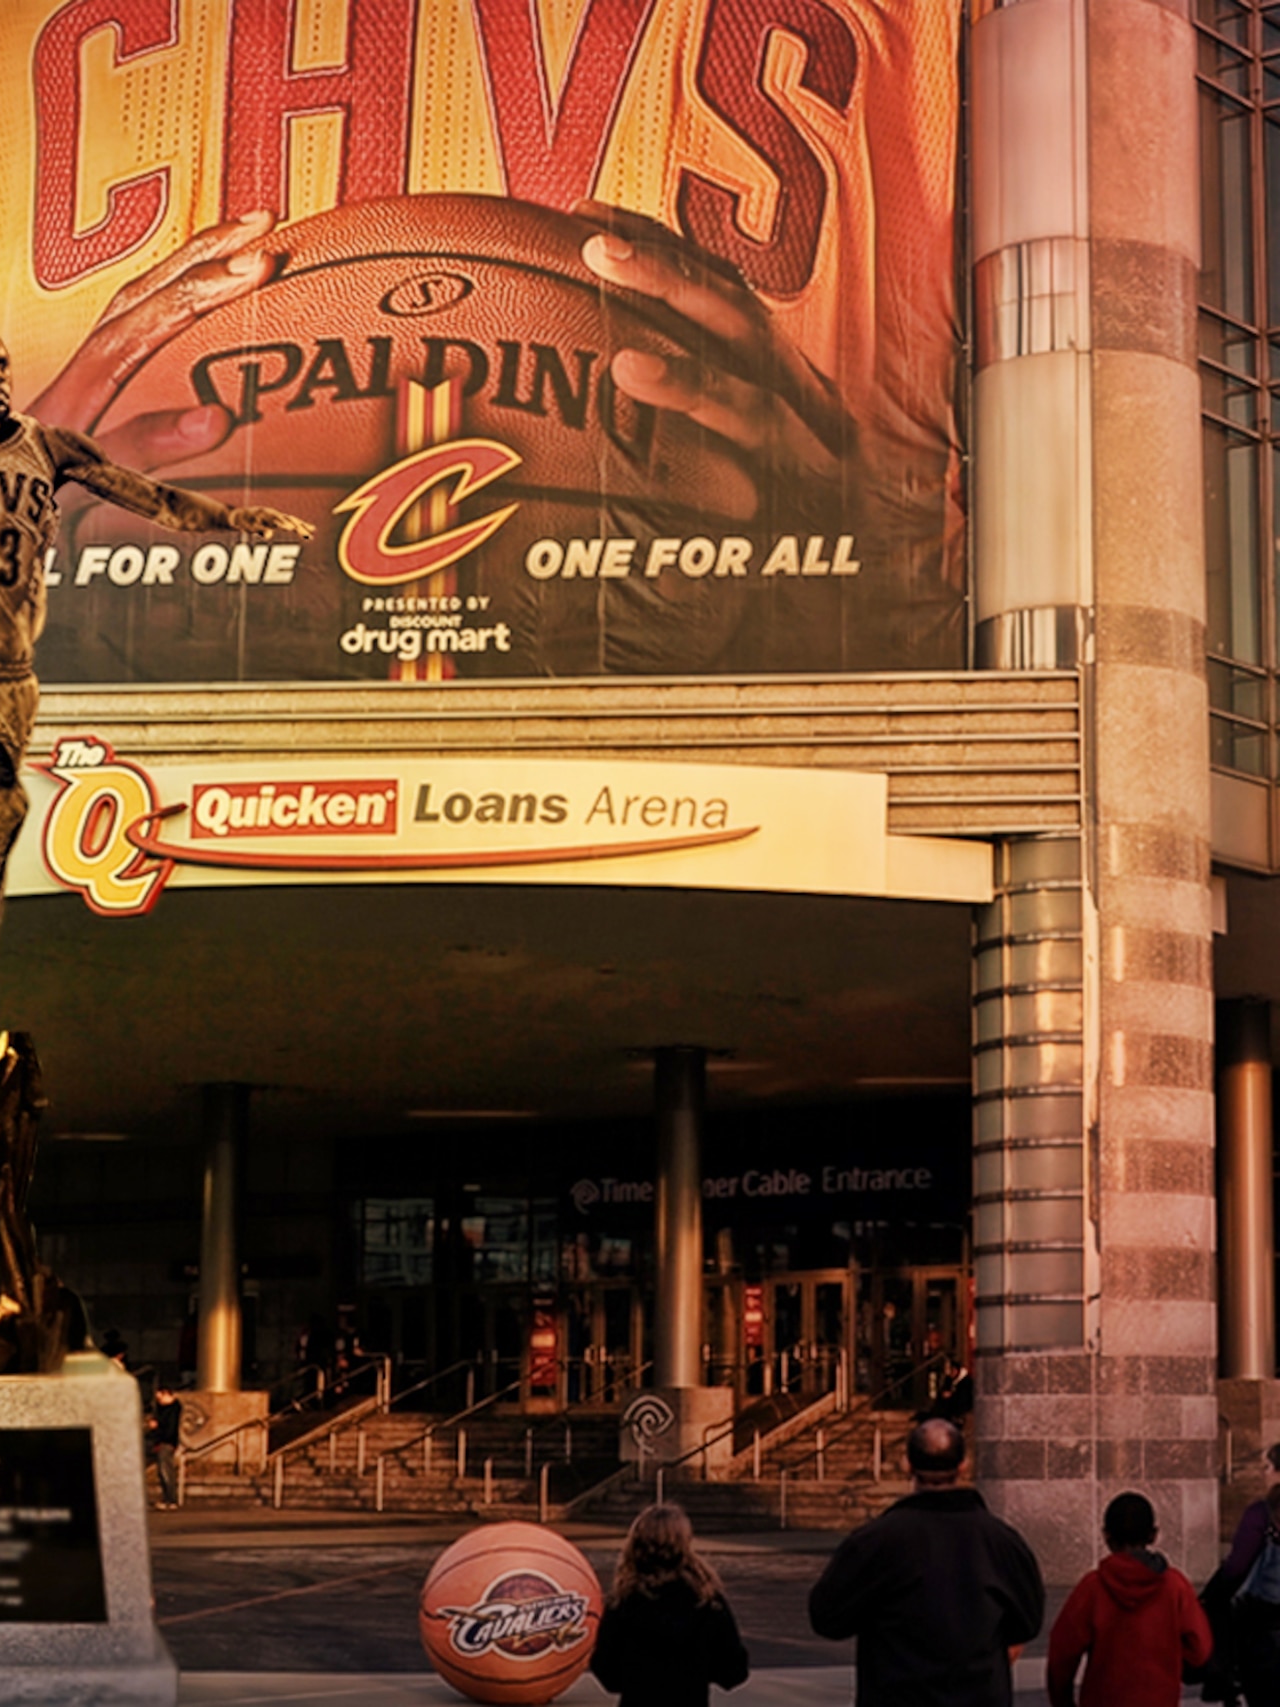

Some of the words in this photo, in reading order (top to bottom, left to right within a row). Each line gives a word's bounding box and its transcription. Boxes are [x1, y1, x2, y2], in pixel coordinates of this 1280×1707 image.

[75, 545, 180, 586] FOR
[191, 544, 300, 585] ONE
[525, 538, 637, 580] ONE
[644, 537, 753, 579] FOR
[760, 535, 862, 576] ALL
[362, 597, 462, 612] PRESENTED
[466, 596, 490, 611] BY
[389, 615, 463, 629] DISCOUNT
[340, 623, 422, 661] drug
[426, 622, 511, 652] mart
[56, 740, 106, 767] The
[413, 783, 569, 824] Loans
[584, 786, 729, 829] Arena
[44, 762, 172, 914] Q
[600, 1178, 654, 1202] Time
[742, 1169, 812, 1197] Cable
[823, 1165, 933, 1193] Entrance
[454, 1600, 584, 1651] CAVALIERS
